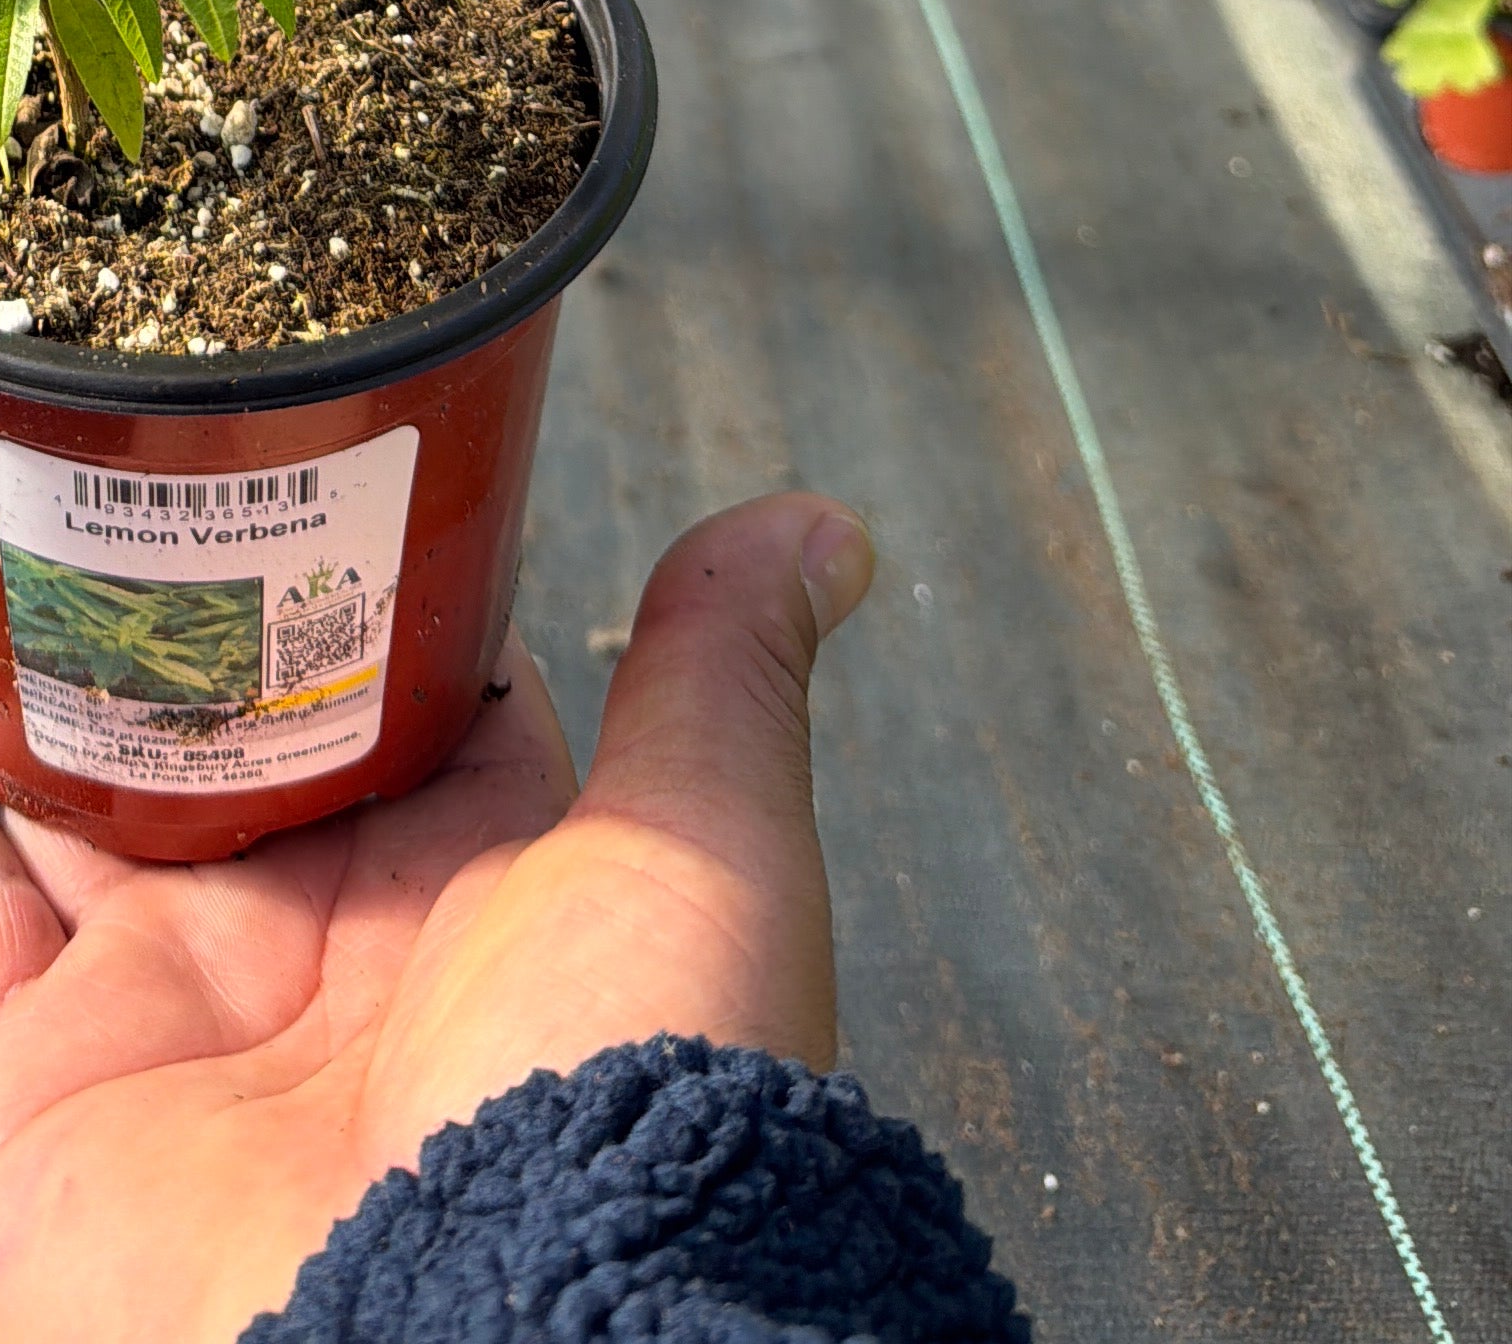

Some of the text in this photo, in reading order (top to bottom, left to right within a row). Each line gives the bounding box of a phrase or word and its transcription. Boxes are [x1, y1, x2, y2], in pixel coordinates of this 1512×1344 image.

[65, 511, 328, 545] Lemon Verbena
[276, 557, 362, 609] AKA
[118, 744, 169, 761] SKU:
[153, 762, 227, 773] Kingsbury
[232, 755, 273, 768] Acres
